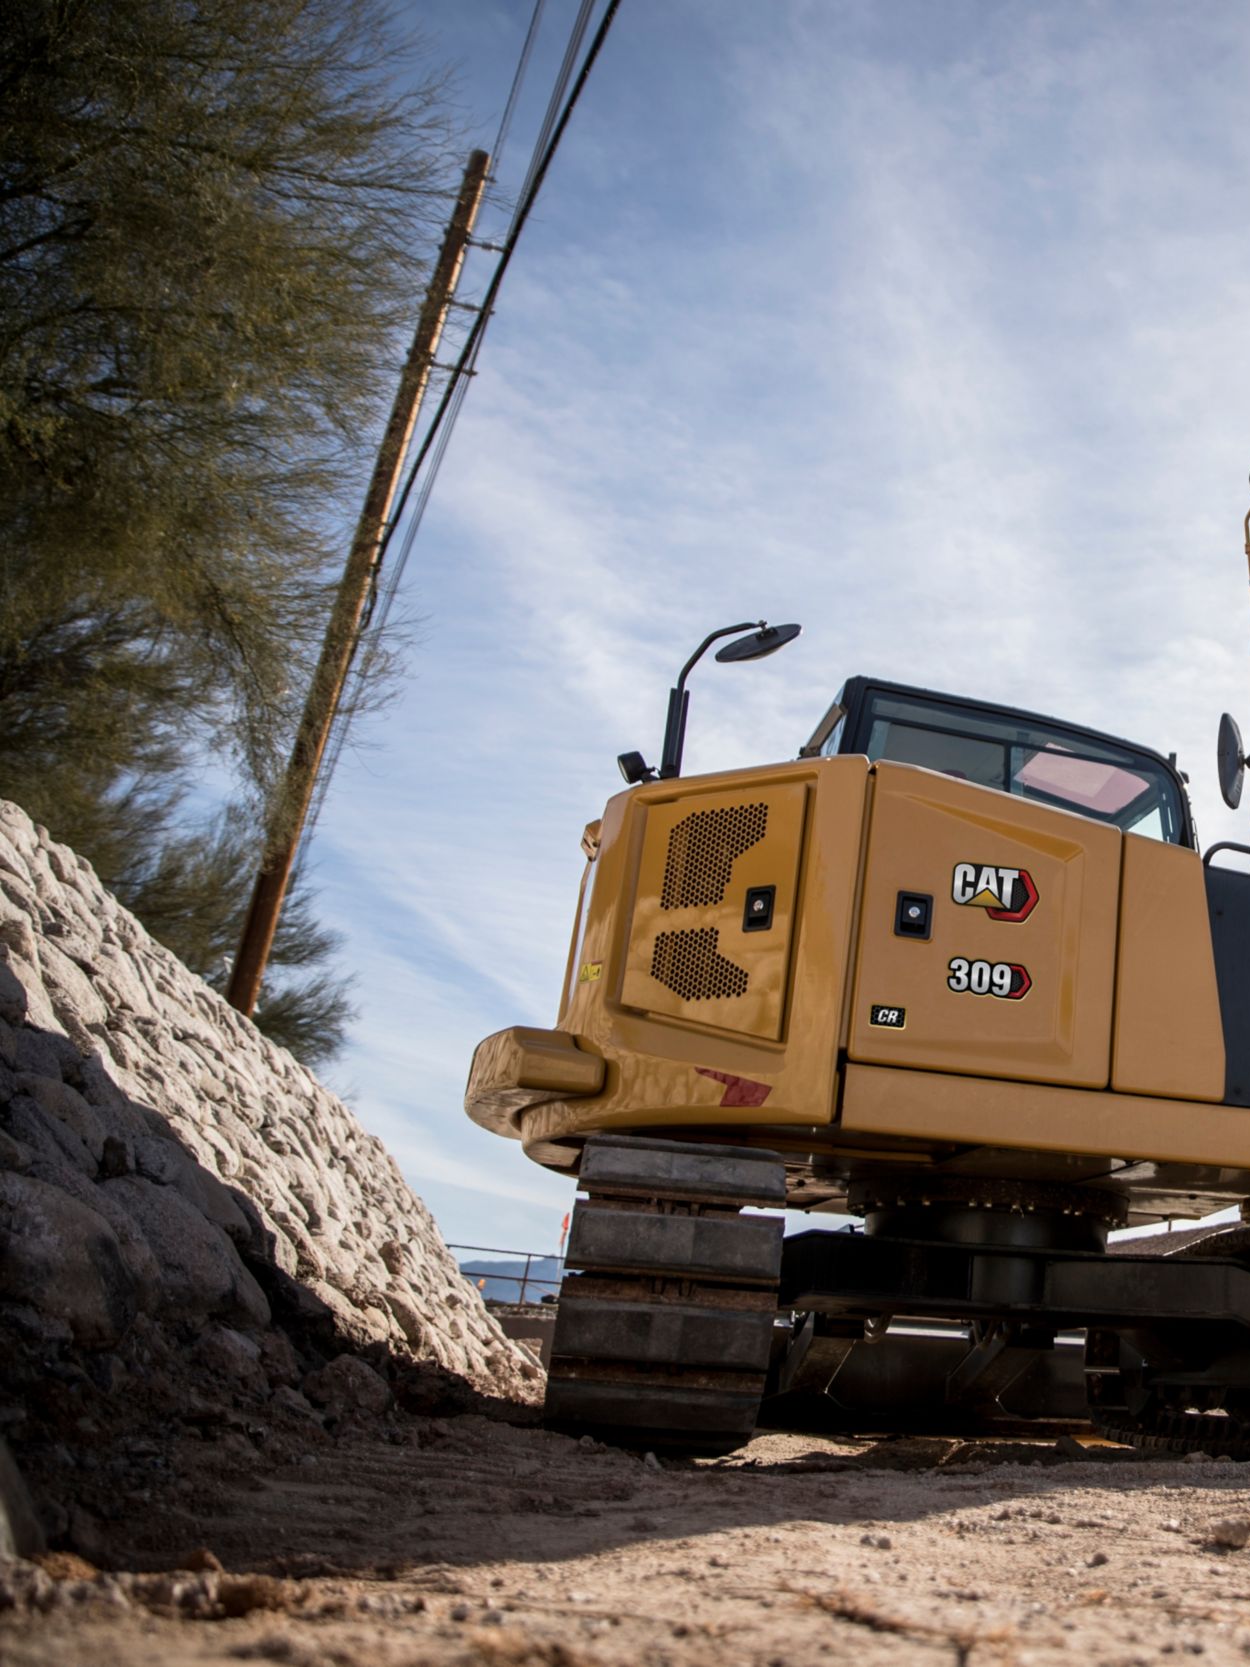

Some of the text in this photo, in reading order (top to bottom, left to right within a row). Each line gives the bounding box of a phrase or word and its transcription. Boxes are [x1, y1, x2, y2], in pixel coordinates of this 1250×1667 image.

[953, 862, 1020, 910] CAT
[949, 957, 1013, 997] 309
[877, 1008, 899, 1023] CR
